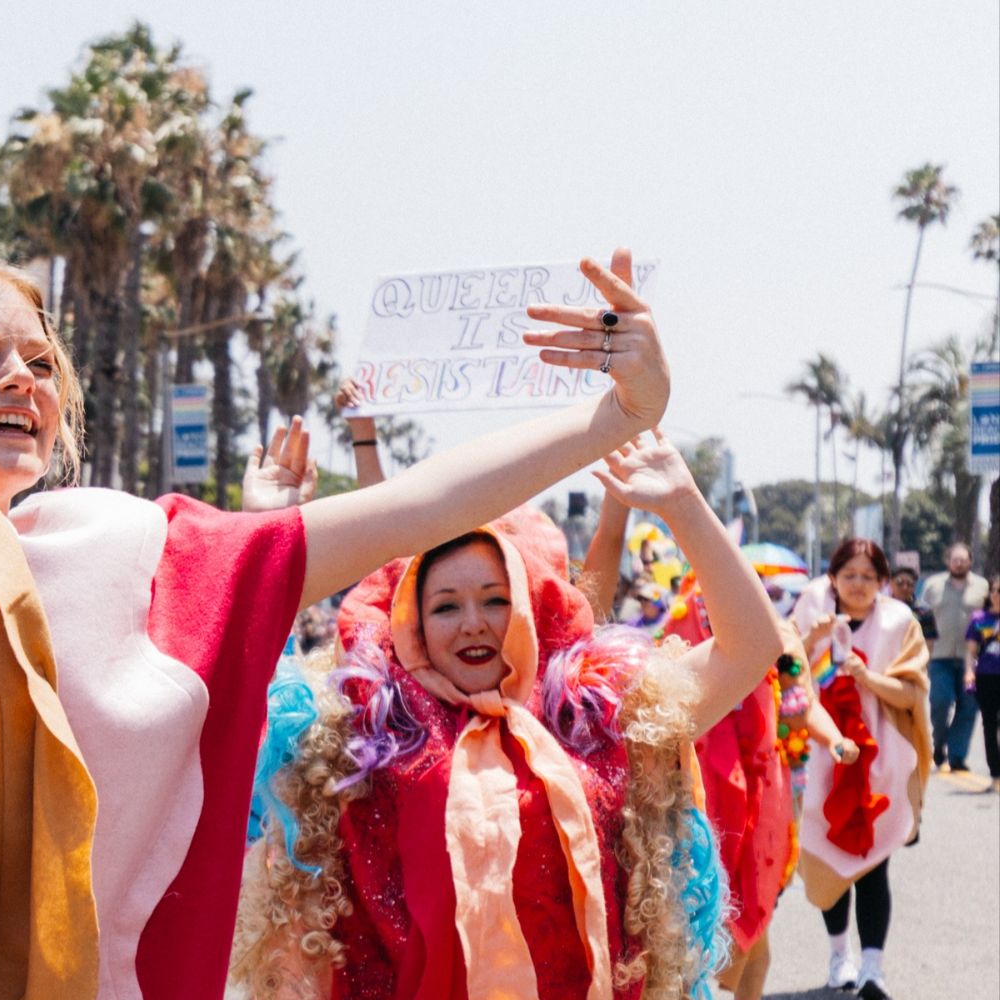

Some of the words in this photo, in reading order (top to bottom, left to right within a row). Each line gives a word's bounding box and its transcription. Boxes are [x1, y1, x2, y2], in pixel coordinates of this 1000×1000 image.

[371, 265, 551, 319] QUEER
[450, 312, 531, 350] IS
[356, 354, 613, 405] RESISTANC
